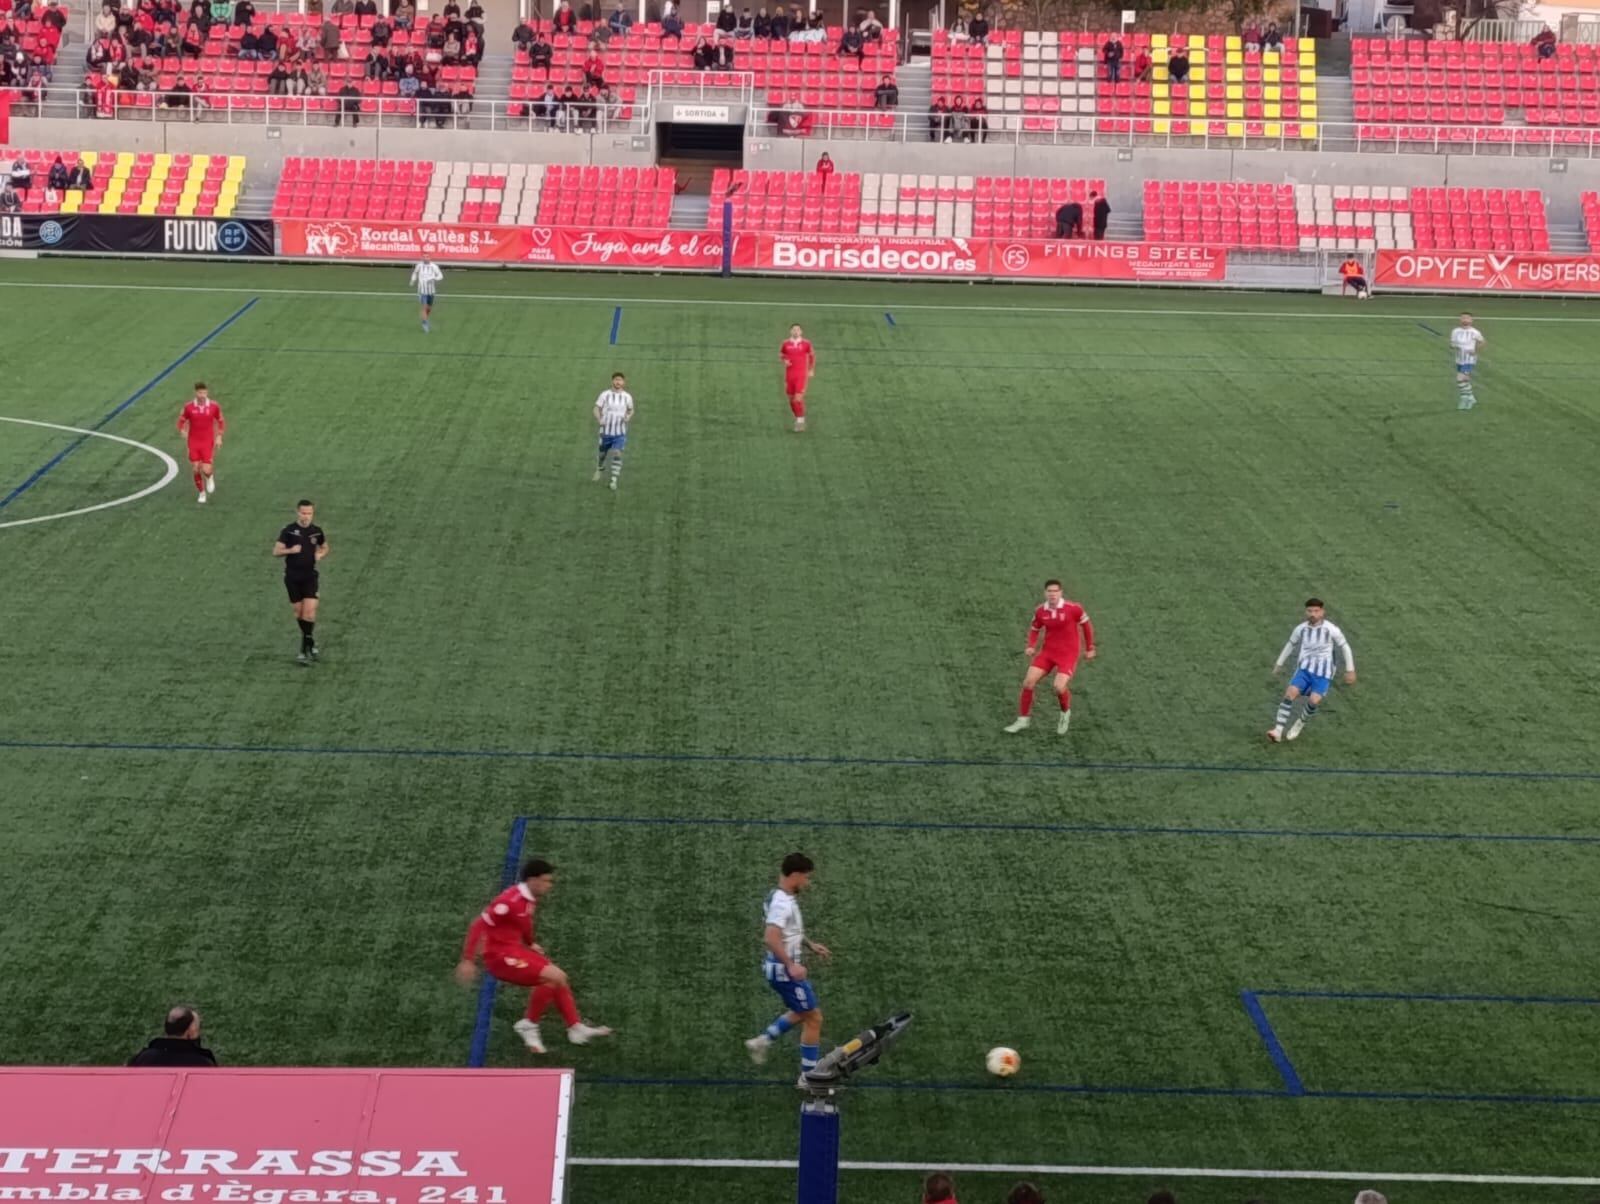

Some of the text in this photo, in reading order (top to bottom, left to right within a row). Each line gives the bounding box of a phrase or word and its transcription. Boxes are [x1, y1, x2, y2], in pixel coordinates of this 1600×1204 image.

[685, 109, 717, 118] SORTIDA
[360, 226, 498, 245] Kordal Vallès S.L.
[774, 234, 817, 243] PINTURA
[819, 236, 880, 245] DECORATIVA
[888, 238, 946, 246] INDUSTRIAL
[305, 235, 341, 255] KV
[361, 242, 480, 254] Mecanitzats de Precisió
[571, 232, 628, 262] Juga
[631, 234, 673, 256] amb
[679, 234, 698, 257] el
[1044, 243, 1215, 261] FITTINGS STEEL
[772, 242, 976, 272] Borisdecor.es
[1006, 250, 1026, 265] FS
[1128, 260, 1190, 268] MECANITZATS
[0, 1148, 468, 1177] TERRASSA
[160, 1179, 397, 1204] d'Ègara,
[418, 1186, 508, 1204] 241
